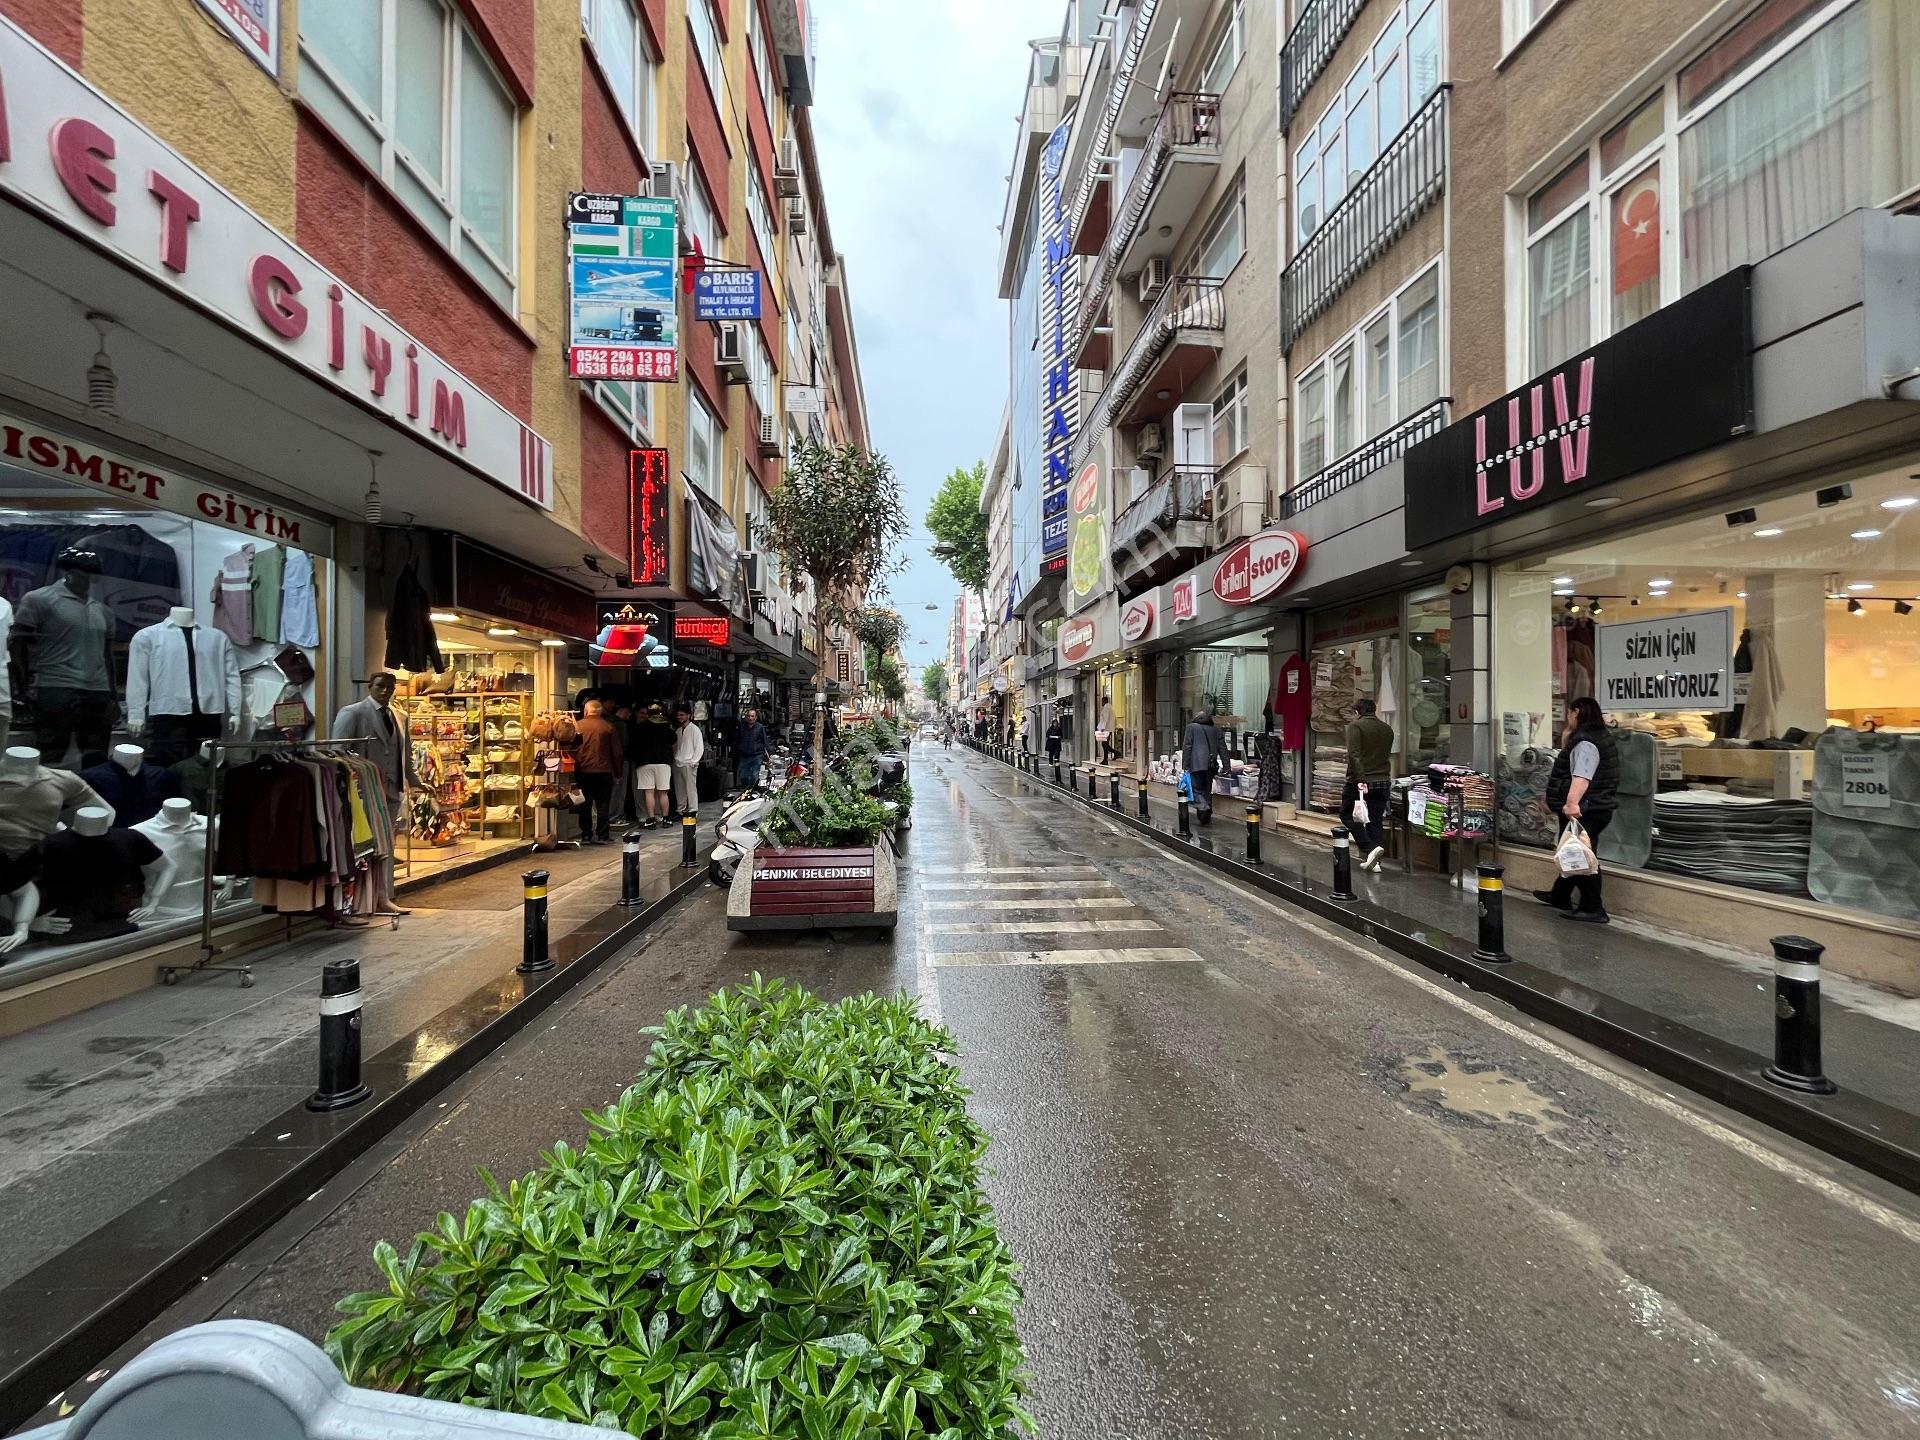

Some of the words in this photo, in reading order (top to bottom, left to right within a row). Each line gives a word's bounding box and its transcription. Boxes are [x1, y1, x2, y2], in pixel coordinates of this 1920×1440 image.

[0, 66, 200, 274] ET
[249, 254, 468, 449] GİYİM
[713, 272, 754, 286] BARIŞ
[576, 350, 608, 362] 0542
[611, 351, 634, 363] 294
[637, 352, 653, 363] 13
[655, 352, 672, 364] 89
[576, 362, 608, 374] 0538
[611, 363, 634, 375] 648
[637, 364, 653, 376] 65
[655, 365, 672, 376] 40
[1475, 356, 1596, 516] LUV
[1476, 414, 1592, 473] ACCESSORIES
[196, 493, 301, 543] GİYİM
[1044, 519, 1068, 540] TEZE
[1251, 549, 1291, 579] store
[677, 622, 725, 635] TÜTÜNCÜ
[1626, 631, 1662, 660] SİZİN
[1666, 626, 1696, 662] İÇİN
[1607, 670, 1720, 700] YENİLENİYORUZ
[1845, 781, 1889, 795] 280₺
